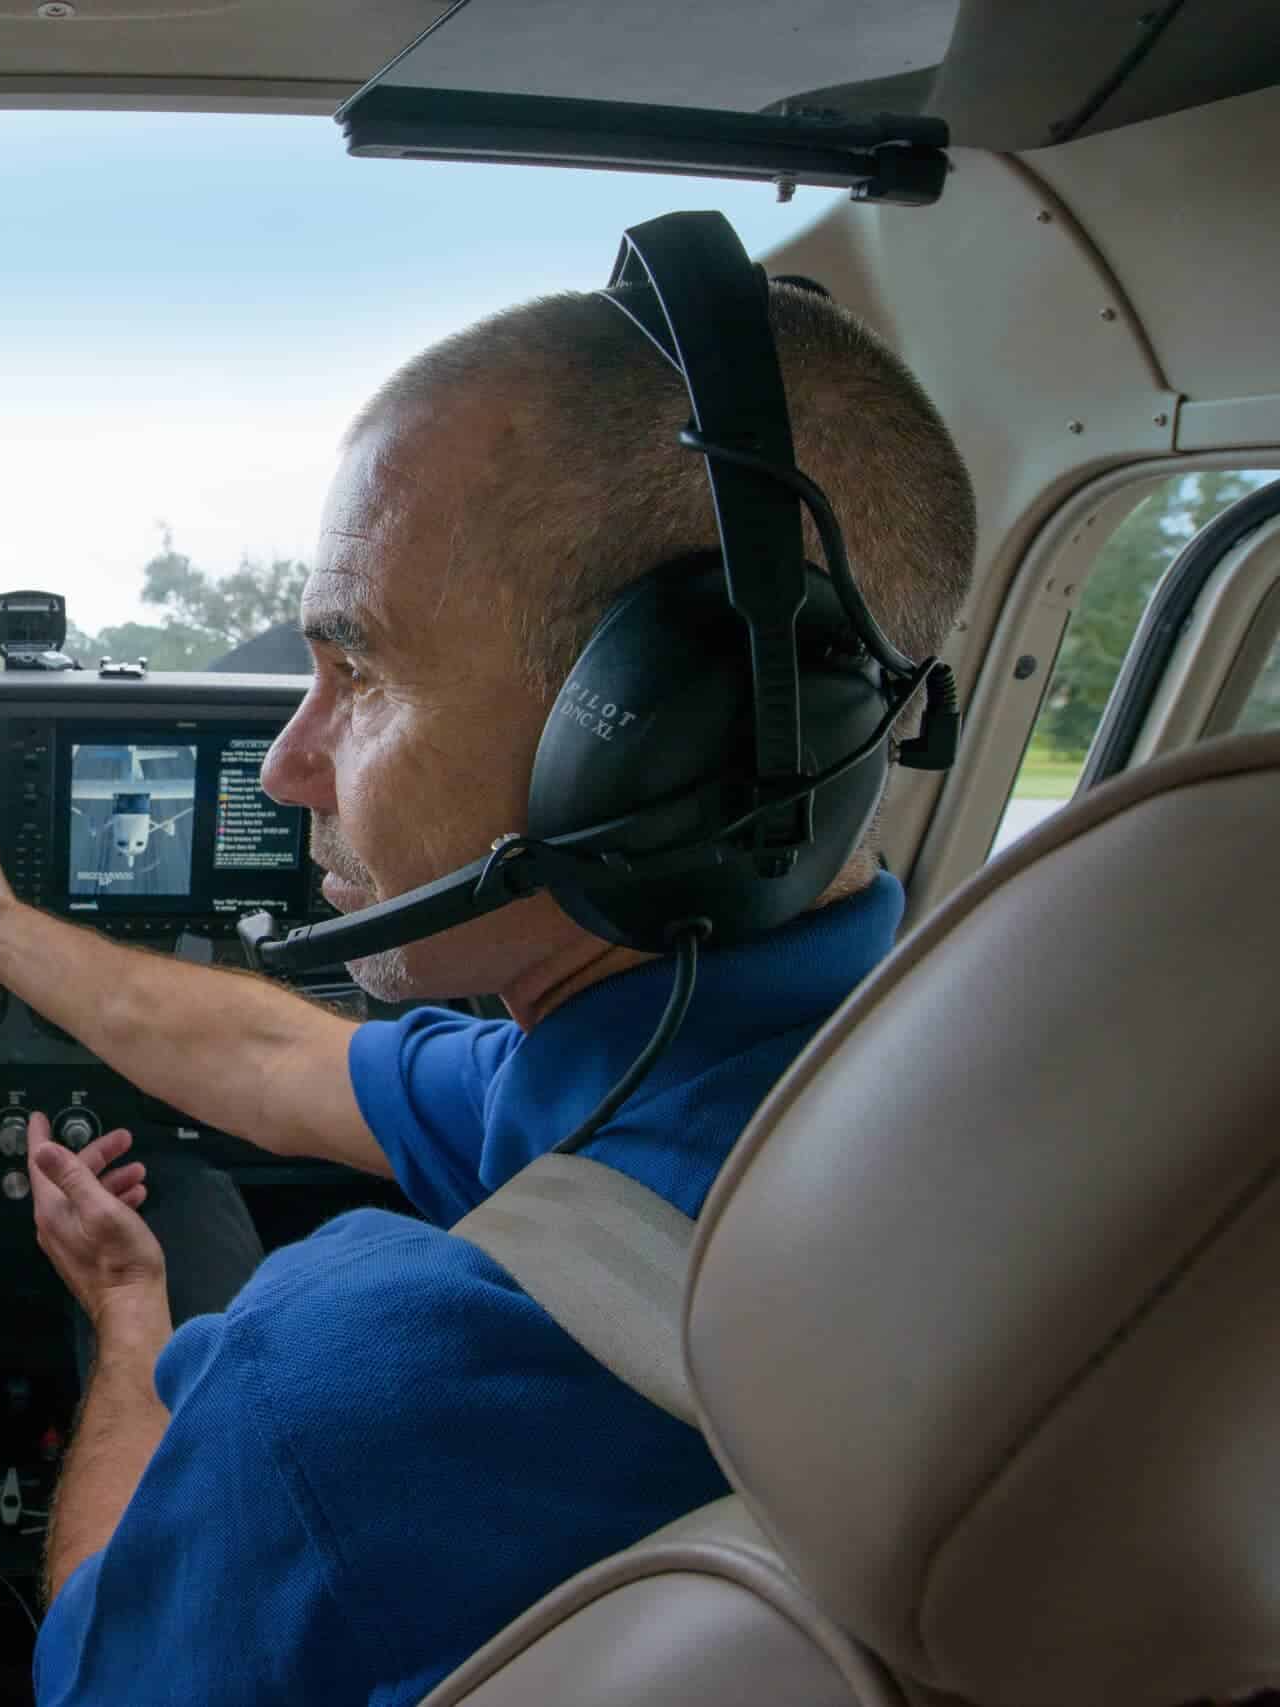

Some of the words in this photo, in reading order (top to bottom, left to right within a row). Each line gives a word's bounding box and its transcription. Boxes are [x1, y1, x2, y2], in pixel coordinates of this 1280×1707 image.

[560, 703, 593, 727] DNC
[592, 719, 616, 741] XL
[566, 682, 636, 726] PILOT
